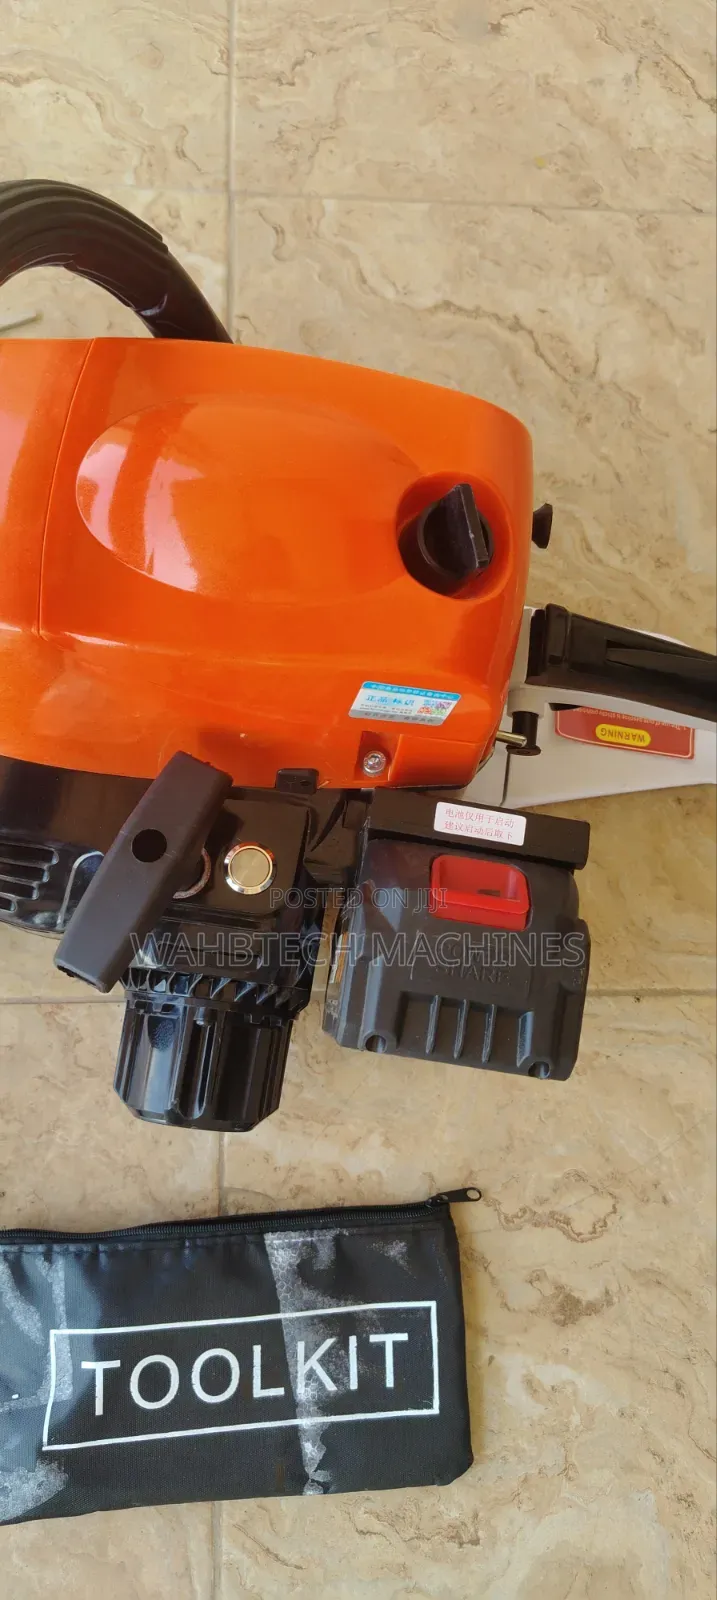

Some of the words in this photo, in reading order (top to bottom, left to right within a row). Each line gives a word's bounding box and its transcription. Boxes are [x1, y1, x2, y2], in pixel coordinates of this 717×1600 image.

[600, 727, 646, 743] WARNING
[445, 808, 515, 829] 电池仅用于启动
[444, 820, 513, 840] 建议启动后取下
[81, 1332, 408, 1416] TOOLKIT
